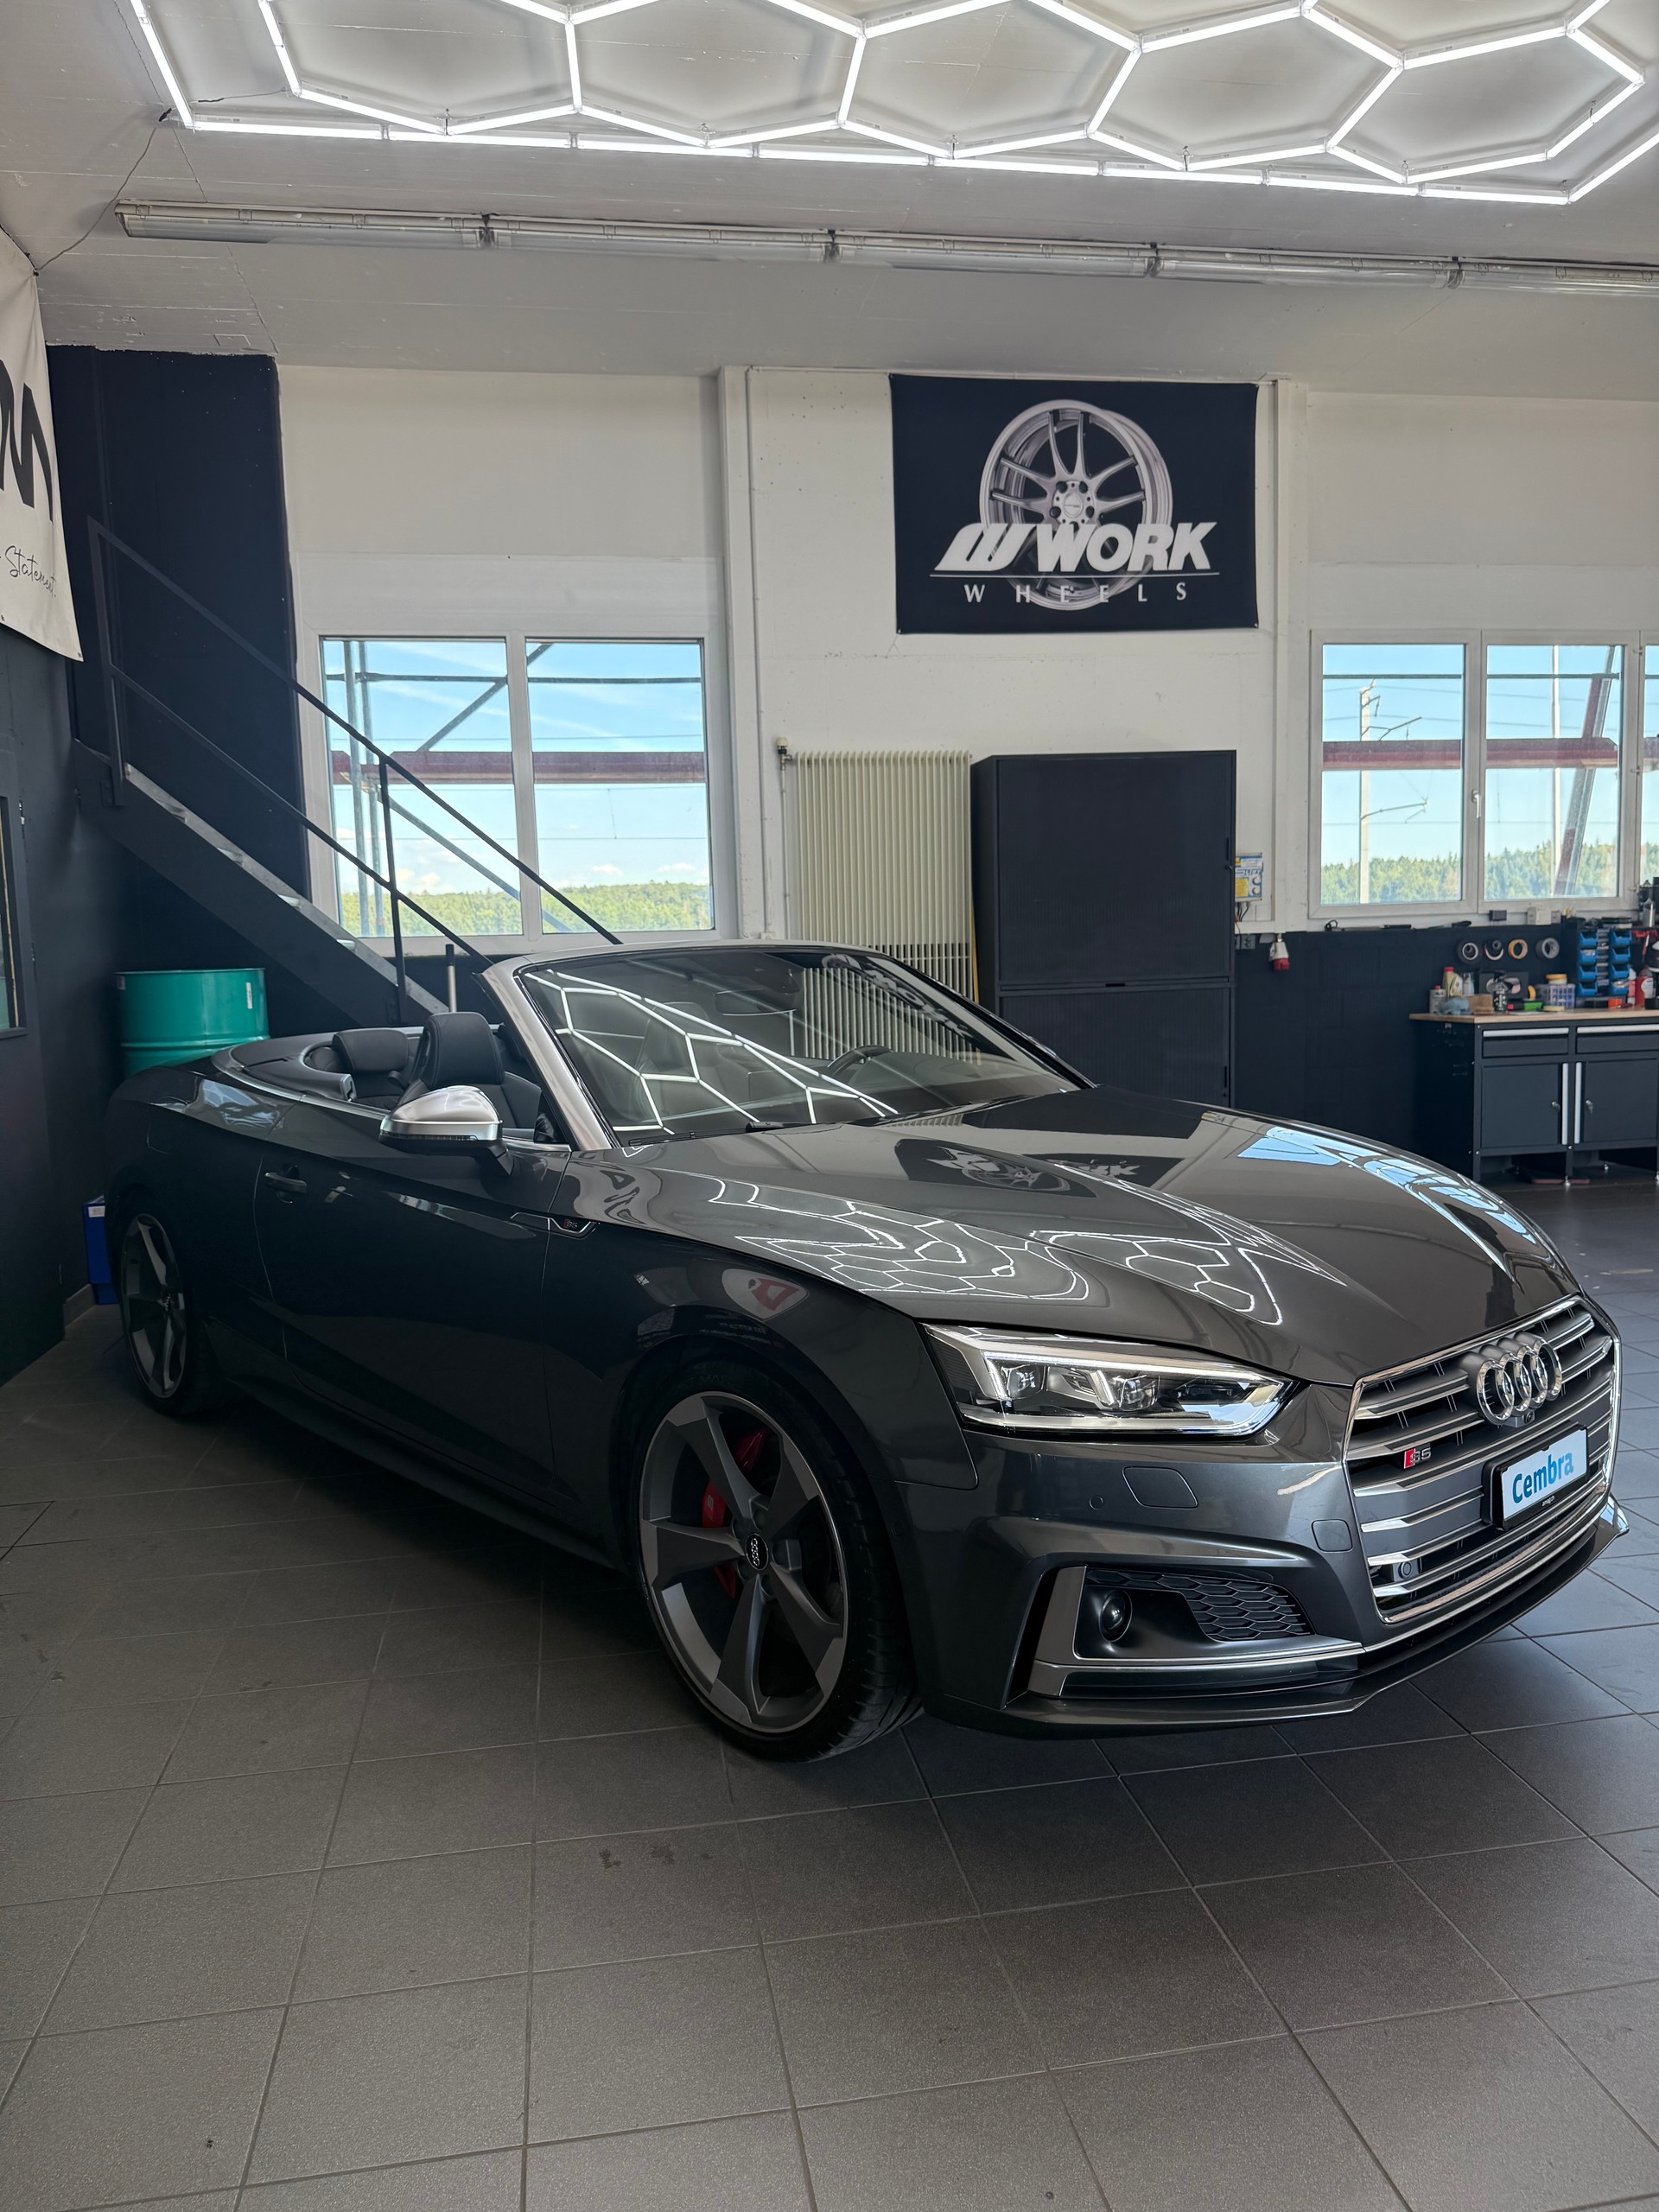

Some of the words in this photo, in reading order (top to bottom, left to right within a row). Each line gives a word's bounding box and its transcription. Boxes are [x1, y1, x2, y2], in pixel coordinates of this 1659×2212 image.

[1037, 522, 1217, 572] WORK
[963, 582, 1187, 603] WHEELS
[1409, 1446, 1432, 1465] S5
[1512, 1452, 1574, 1504] Cembra
